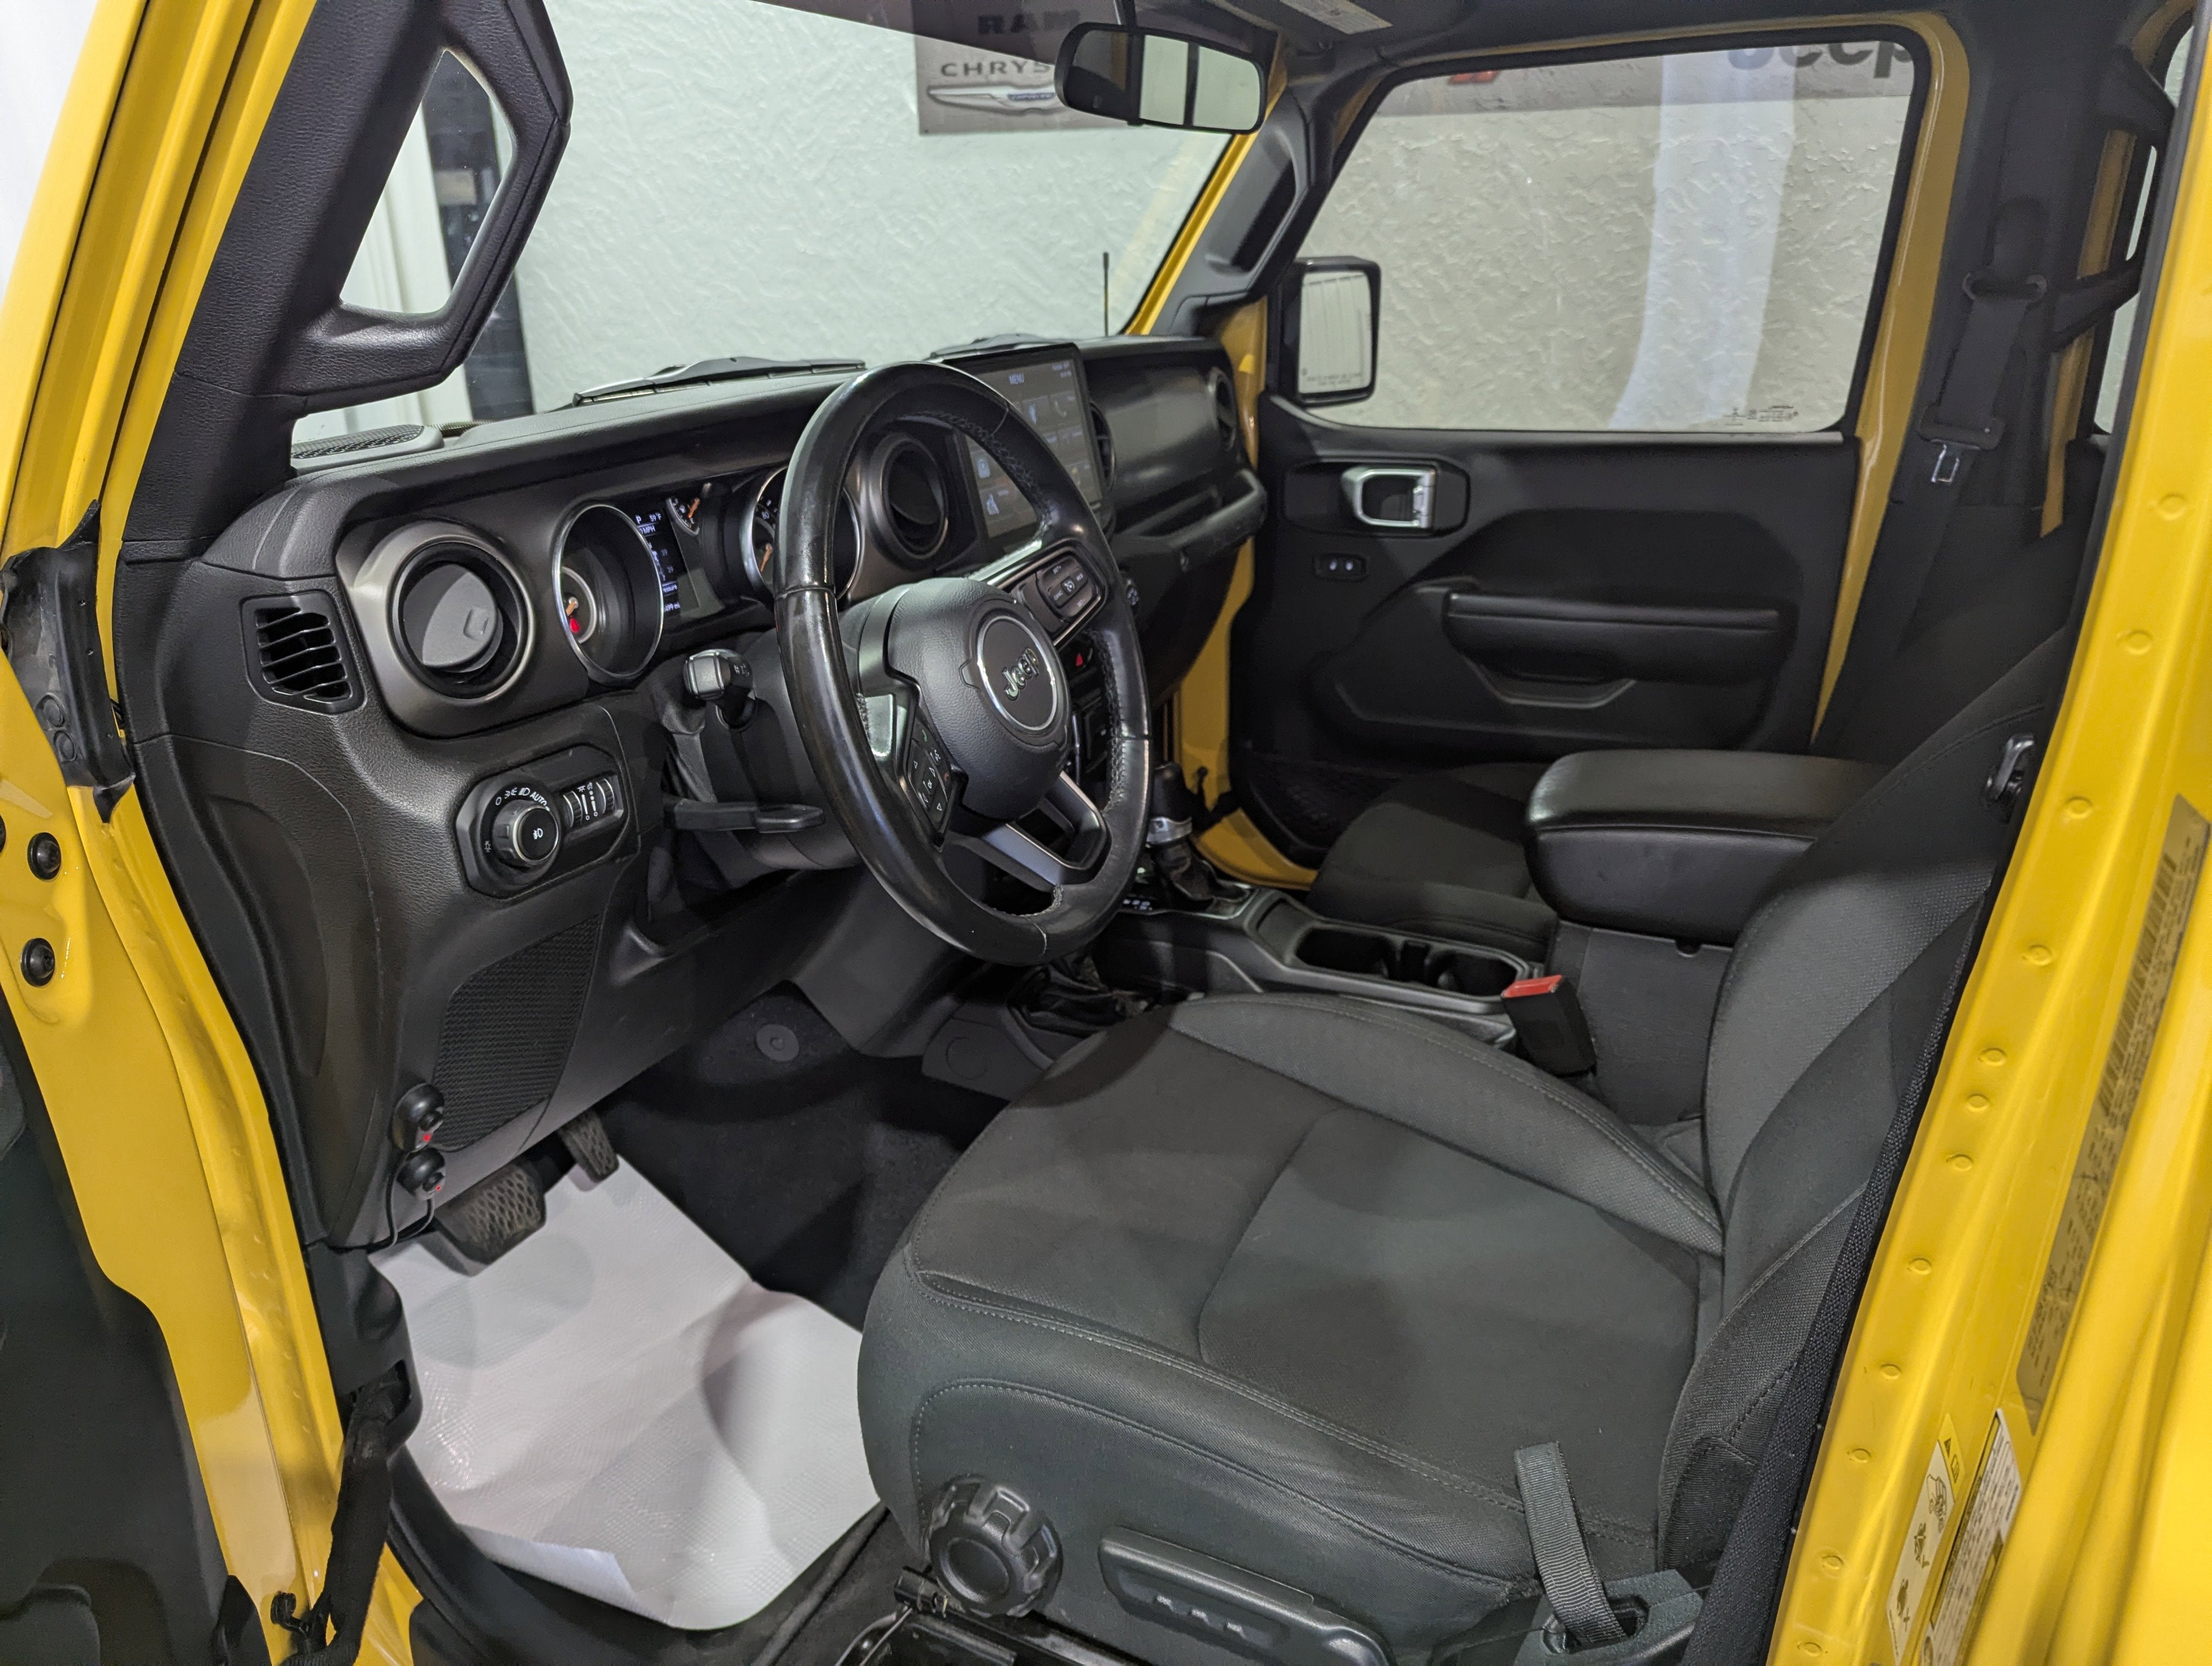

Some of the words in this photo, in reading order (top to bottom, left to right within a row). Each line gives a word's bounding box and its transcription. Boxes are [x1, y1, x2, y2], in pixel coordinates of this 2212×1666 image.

[978, 10, 1079, 34] RAM
[1009, 373, 1024, 384] MENU
[635, 515, 642, 524] P
[1002, 648, 1039, 697] Jeep
[530, 791, 547, 806] AUTO
